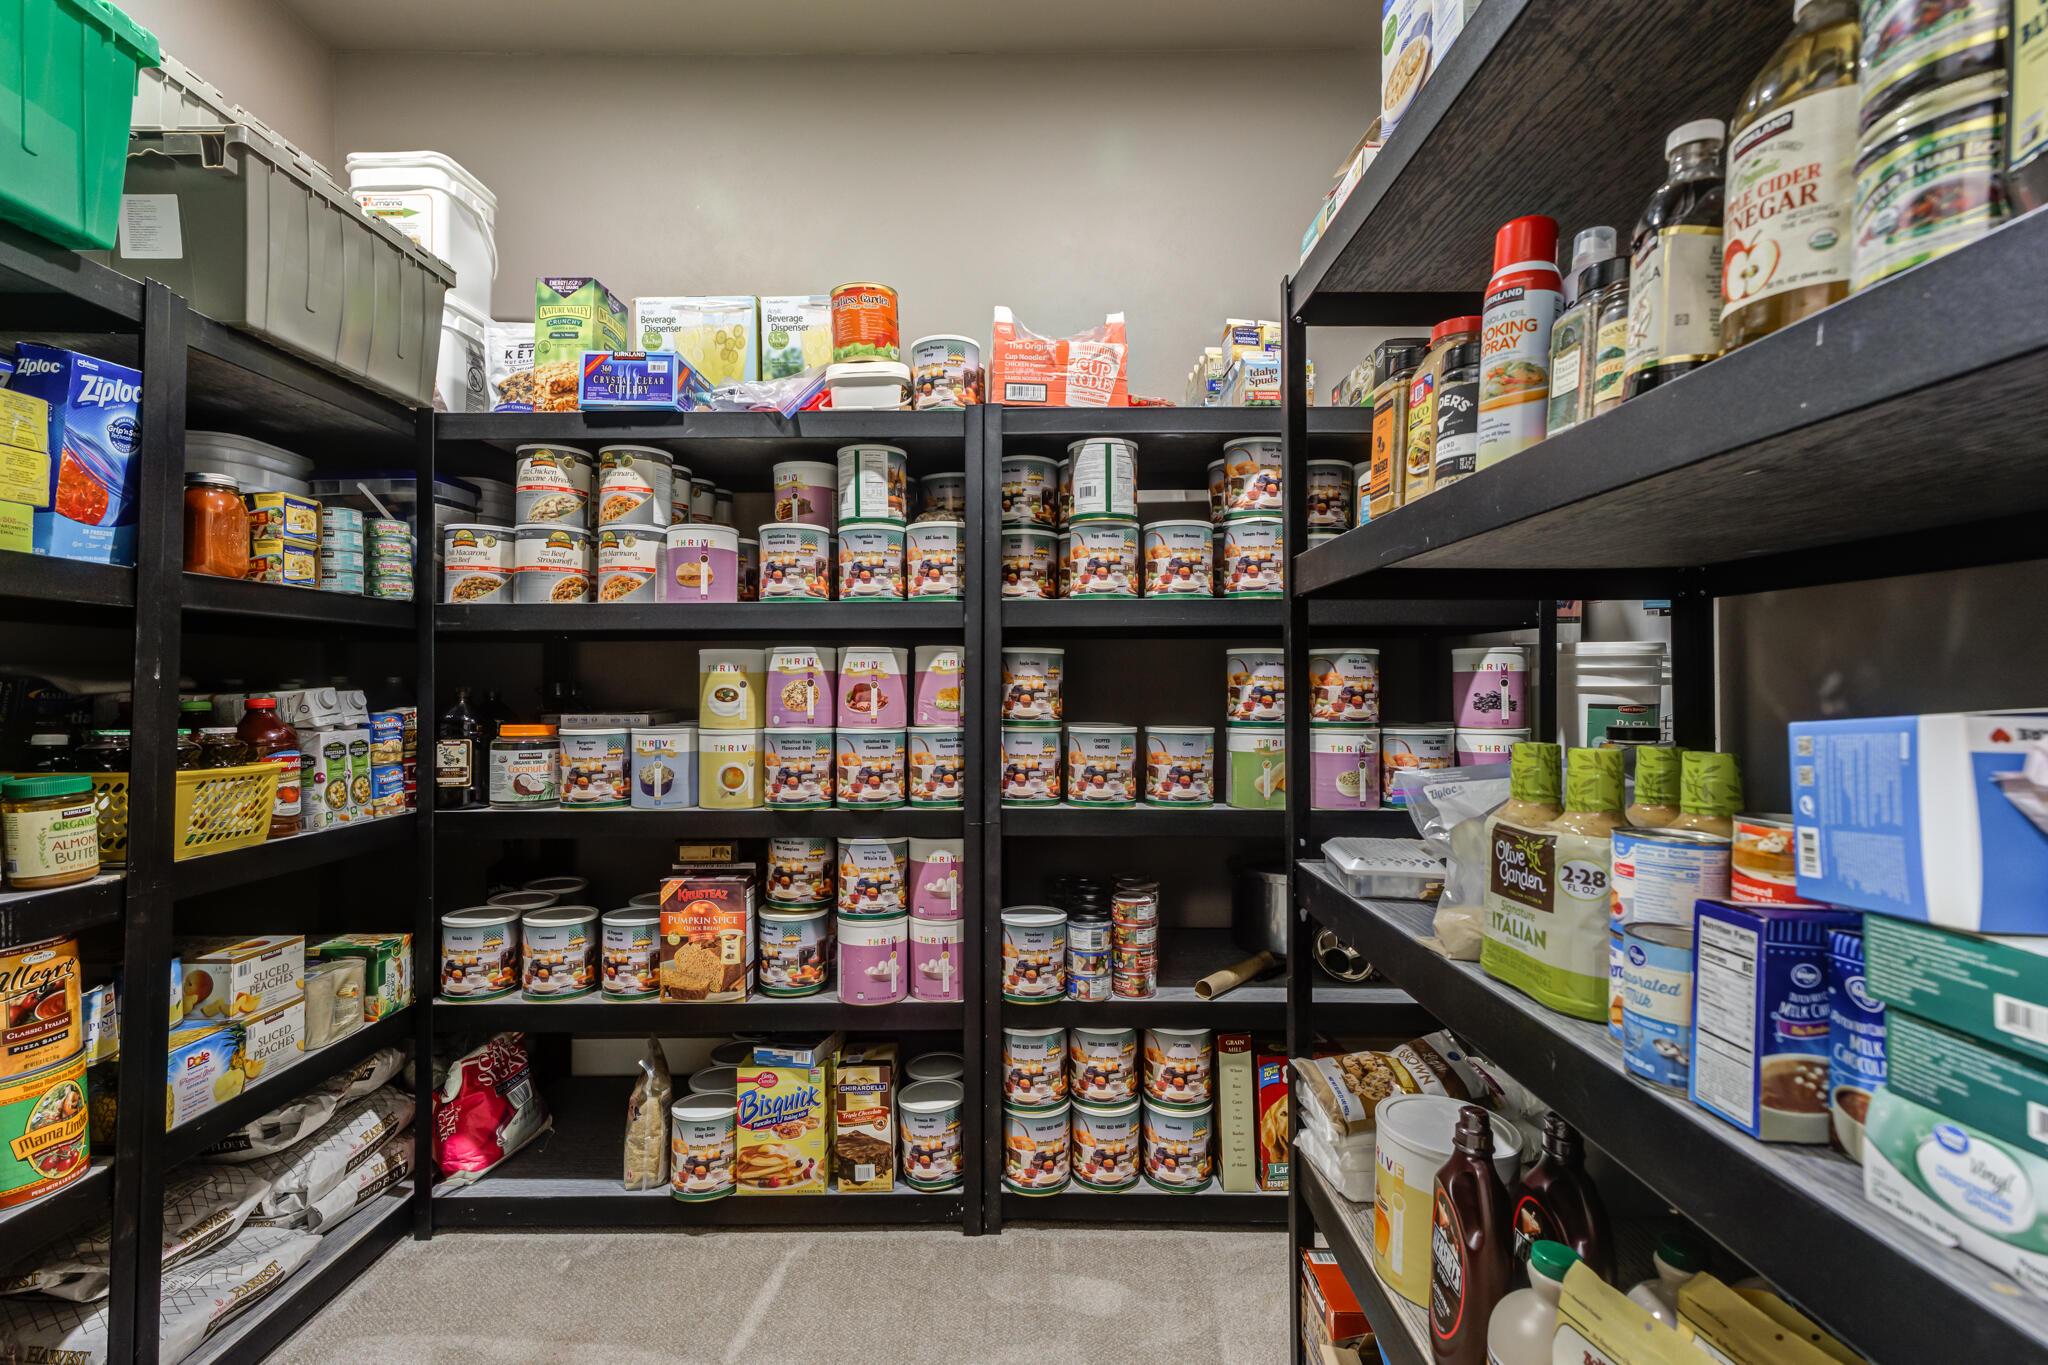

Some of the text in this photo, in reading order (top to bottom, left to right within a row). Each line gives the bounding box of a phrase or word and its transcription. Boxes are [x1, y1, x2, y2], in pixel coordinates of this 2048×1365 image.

[1735, 111, 1792, 153] KIRKLAND
[1757, 162, 1823, 200] CIDER
[859, 294, 890, 307] Garden
[541, 306, 589, 317] NATURE VALLEY
[640, 316, 677, 325] Beverage
[767, 315, 804, 324] Beverage
[644, 324, 682, 334] Dispenser
[770, 324, 809, 333] Dispenser
[1005, 353, 1046, 361] Cup Noodles
[15, 358, 61, 376] Ziploc
[600, 364, 612, 373] 360
[1079, 358, 1112, 376] CUP
[1249, 367, 1279, 377] Idaho
[593, 375, 665, 385] CRYSTAL CLEAR
[1249, 375, 1279, 387] Spuds
[77, 374, 143, 408] Ziploc
[608, 384, 650, 395] CUTLERY
[1410, 405, 1430, 421] TACO
[529, 467, 557, 475] Chicken
[675, 539, 715, 547] THRIVE
[455, 549, 488, 557] Macaroni
[551, 550, 567, 558] Beef
[537, 556, 573, 566] Stroganoff
[780, 657, 820, 666] THRIVE
[848, 661, 884, 669] THRIVE
[1471, 663, 1515, 672] THRIVE
[707, 664, 747, 673] THRIVE
[637, 739, 675, 748] THRIVE
[713, 744, 755, 752] THRIVE
[1257, 739, 1282, 747] THRI
[1330, 744, 1371, 753] THRIVE
[508, 763, 542, 773] Coconut
[1428, 784, 1457, 801] Ziploc
[63, 807, 91, 817] KIRKLAND
[53, 816, 96, 831] ORGANIC
[55, 847, 98, 864] BUTTER
[926, 855, 961, 863] THRIVE
[1495, 840, 1526, 866] Olive
[1499, 862, 1548, 892] Garden
[1562, 865, 1607, 888] 2-28
[677, 889, 728, 902] KRUSTEAZ
[1500, 898, 1536, 923] Signature
[668, 915, 738, 926] PUMPKIN SPICE
[1492, 911, 1547, 951] ITALIAN
[1701, 919, 1756, 944] Nutrition Facts
[867, 936, 901, 945] THRIVE
[919, 936, 954, 944] THRIVE
[1701, 949, 1727, 965] Calories
[253, 962, 290, 984] SLICED
[249, 971, 294, 996] PEACHES
[1778, 1001, 1810, 1018] MILK
[6, 1016, 70, 1041] CLASSIC ITALIAN
[258, 1024, 292, 1048] SLICED
[13, 1032, 68, 1053] PIZZA SAUCE
[253, 1034, 295, 1061] PEACHES
[1849, 1033, 1886, 1058] MILK
[187, 1051, 210, 1068] Dole
[1400, 1049, 1436, 1086] BROWN
[839, 1083, 886, 1092] GHIRARDELLI
[739, 1086, 821, 1125] Bisquick
[859, 1110, 883, 1118] Chocolate
[360, 1111, 398, 1145] HARVEST
[753, 1120, 771, 1129] Pancake
[18, 1110, 88, 1155] Mama Linda
[1274, 1164, 1288, 1174] Lar
[1970, 1157, 2017, 1193] Vinyl
[47, 1180, 60, 1190] NETO
[180, 1207, 233, 1245] HARVEST
[228, 1259, 284, 1300] HARVEST
[25, 1345, 92, 1365] HARVEST
